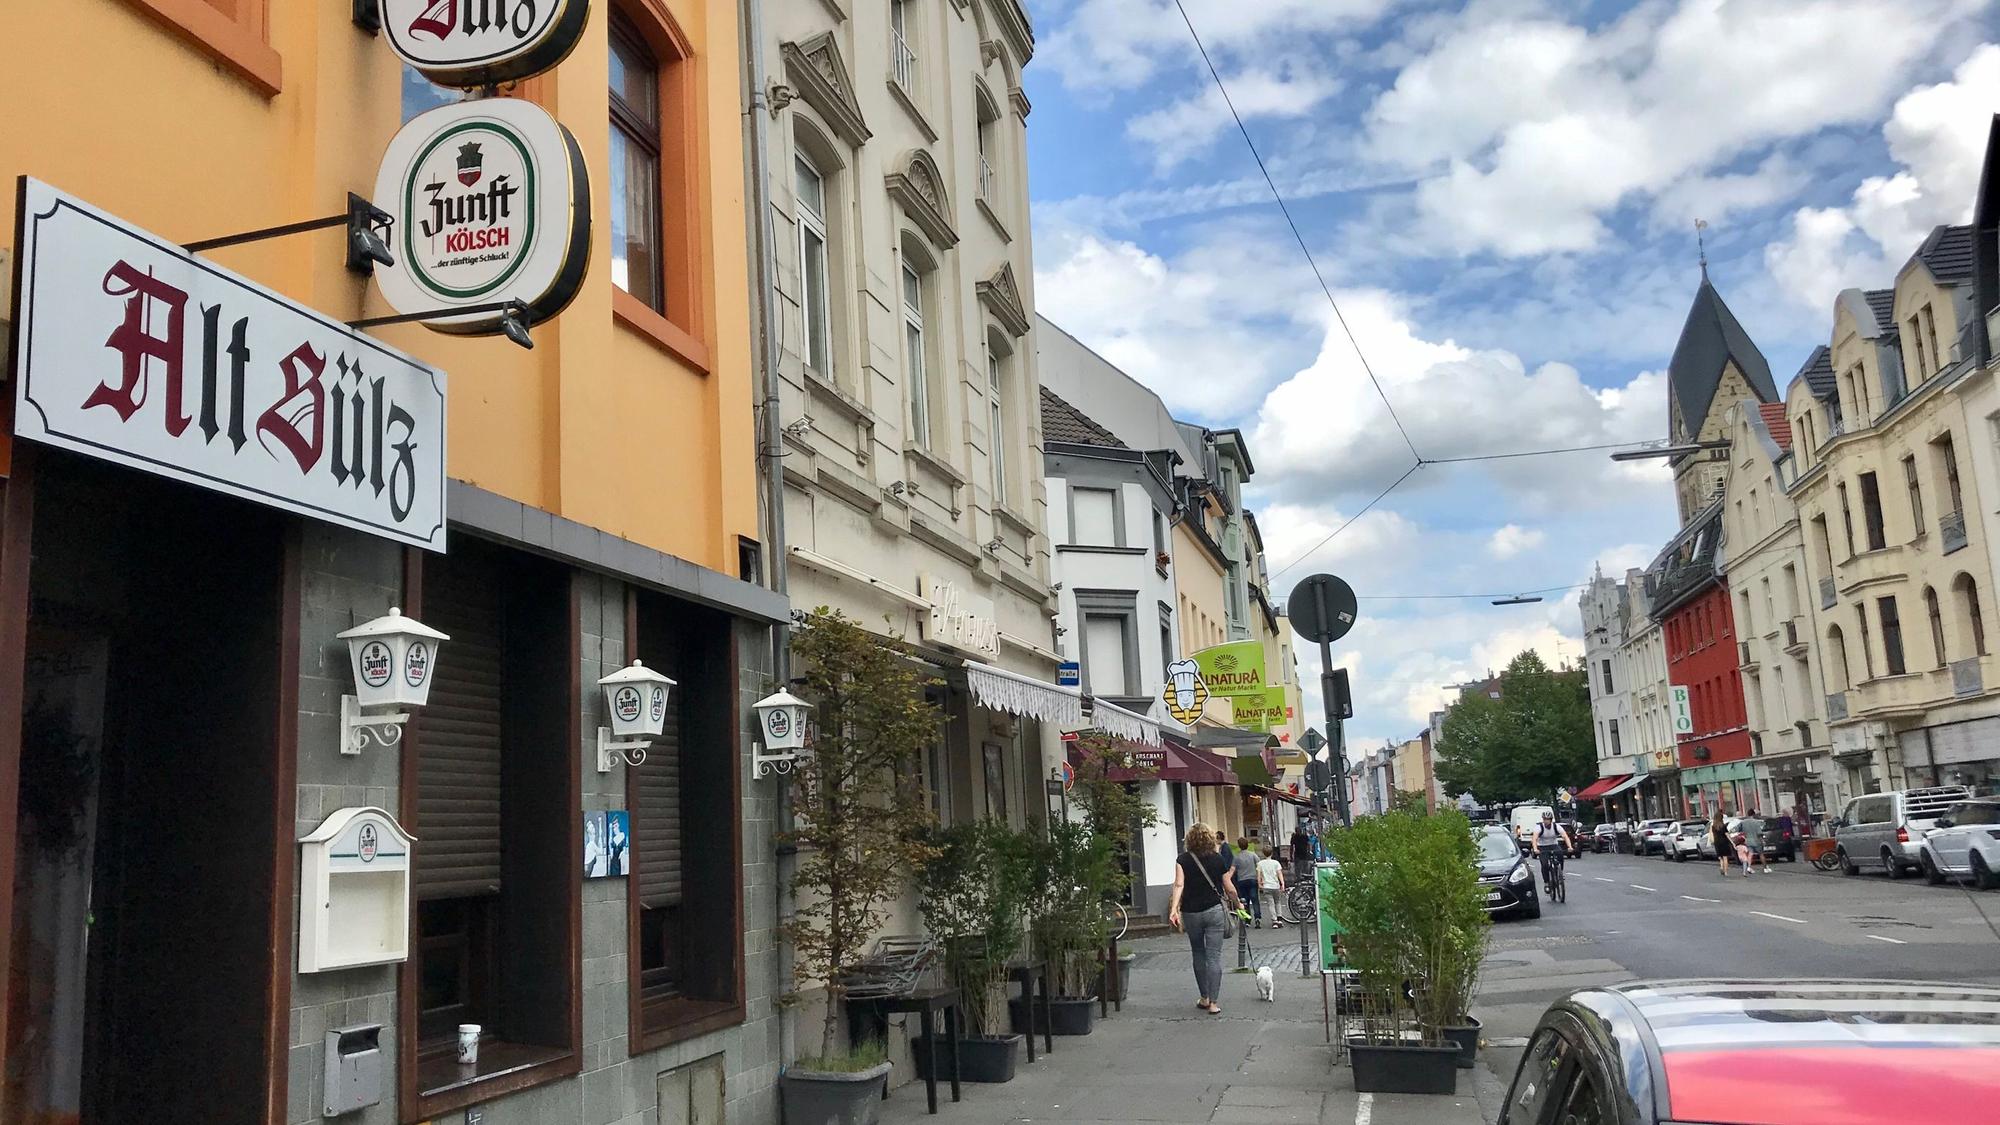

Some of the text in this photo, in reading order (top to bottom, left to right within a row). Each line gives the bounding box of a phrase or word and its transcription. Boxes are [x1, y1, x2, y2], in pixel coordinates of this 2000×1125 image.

[418, 173, 520, 238] Zunft
[446, 227, 509, 254] KÖLSCH
[449, 256, 479, 266] zünftige
[81, 259, 418, 523] Alt Sülz
[364, 656, 388, 671] Zunft
[1674, 689, 1690, 730] BIO
